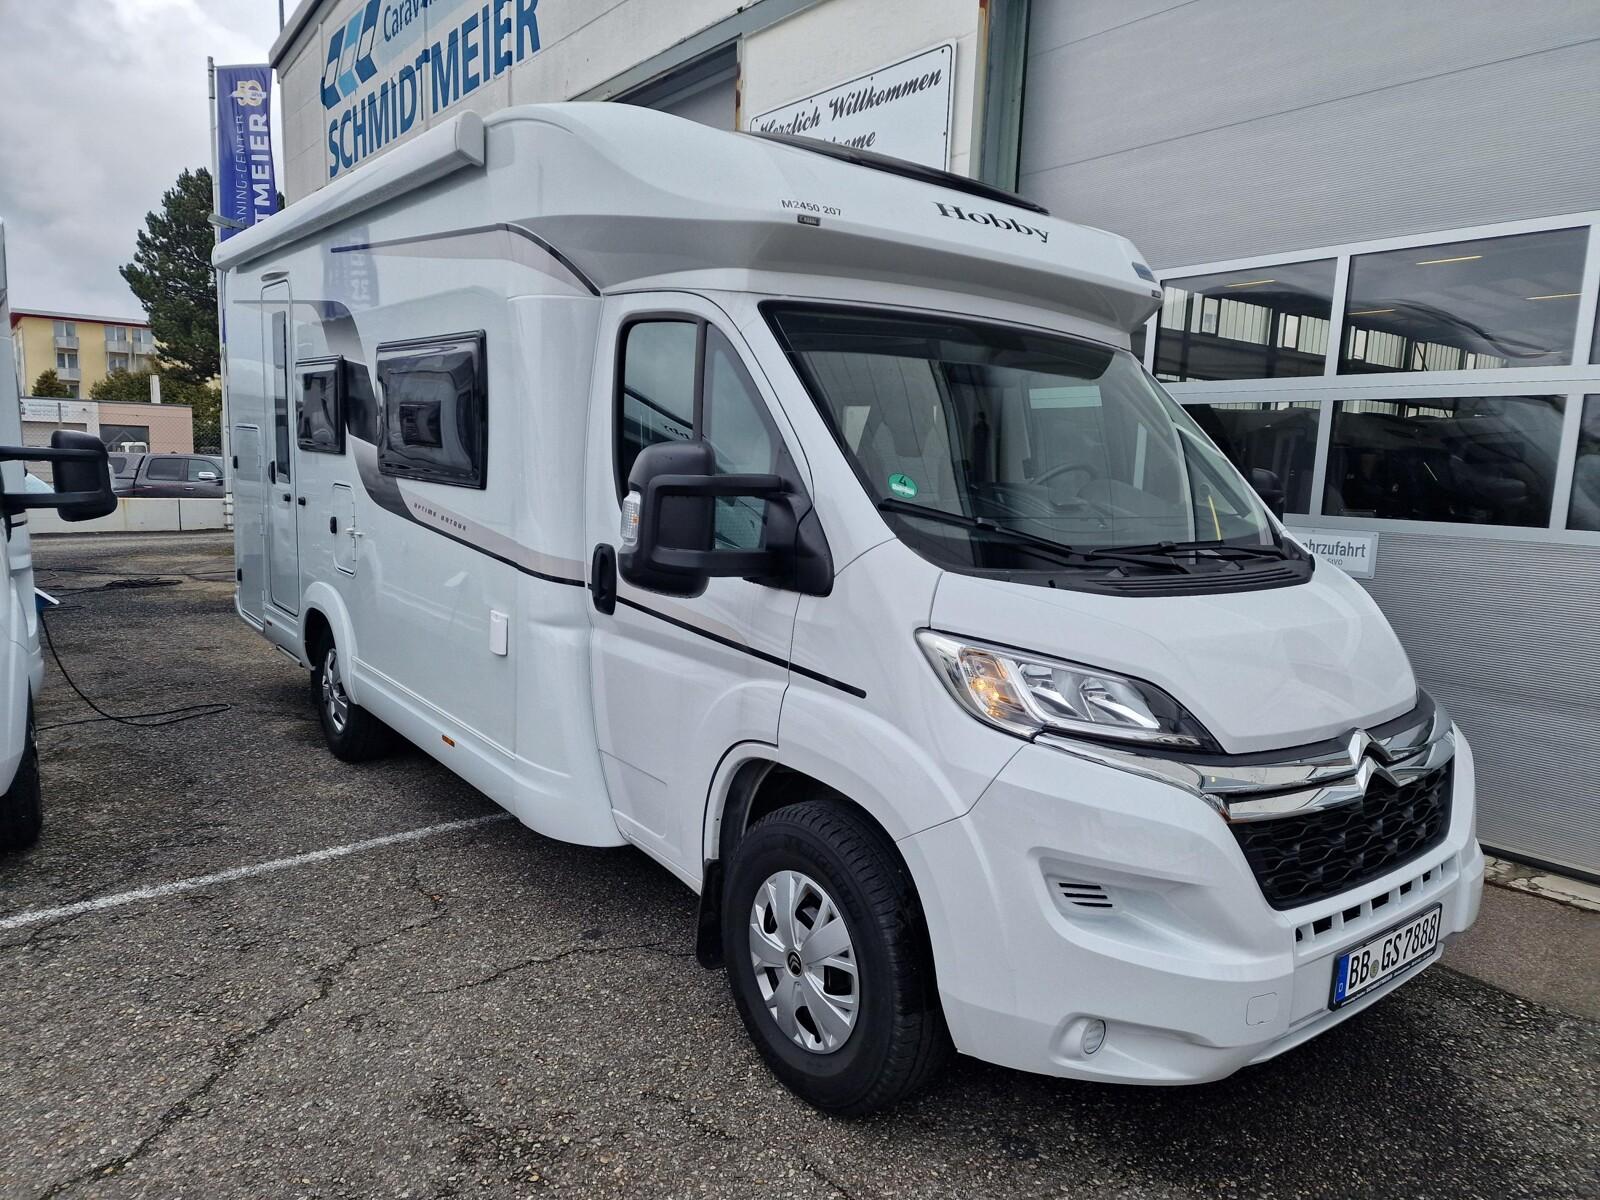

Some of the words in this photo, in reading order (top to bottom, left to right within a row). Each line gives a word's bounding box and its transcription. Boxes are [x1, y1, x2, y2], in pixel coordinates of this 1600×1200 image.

[384, 0, 439, 42] Carav
[329, 0, 541, 178] SCHMIDTMEIER
[829, 69, 941, 121] Willkommen
[781, 199, 820, 212] M2450
[822, 205, 841, 216] 207
[931, 201, 1050, 243] Hobby
[1338, 982, 1344, 993] D
[1348, 949, 1371, 990] BB
